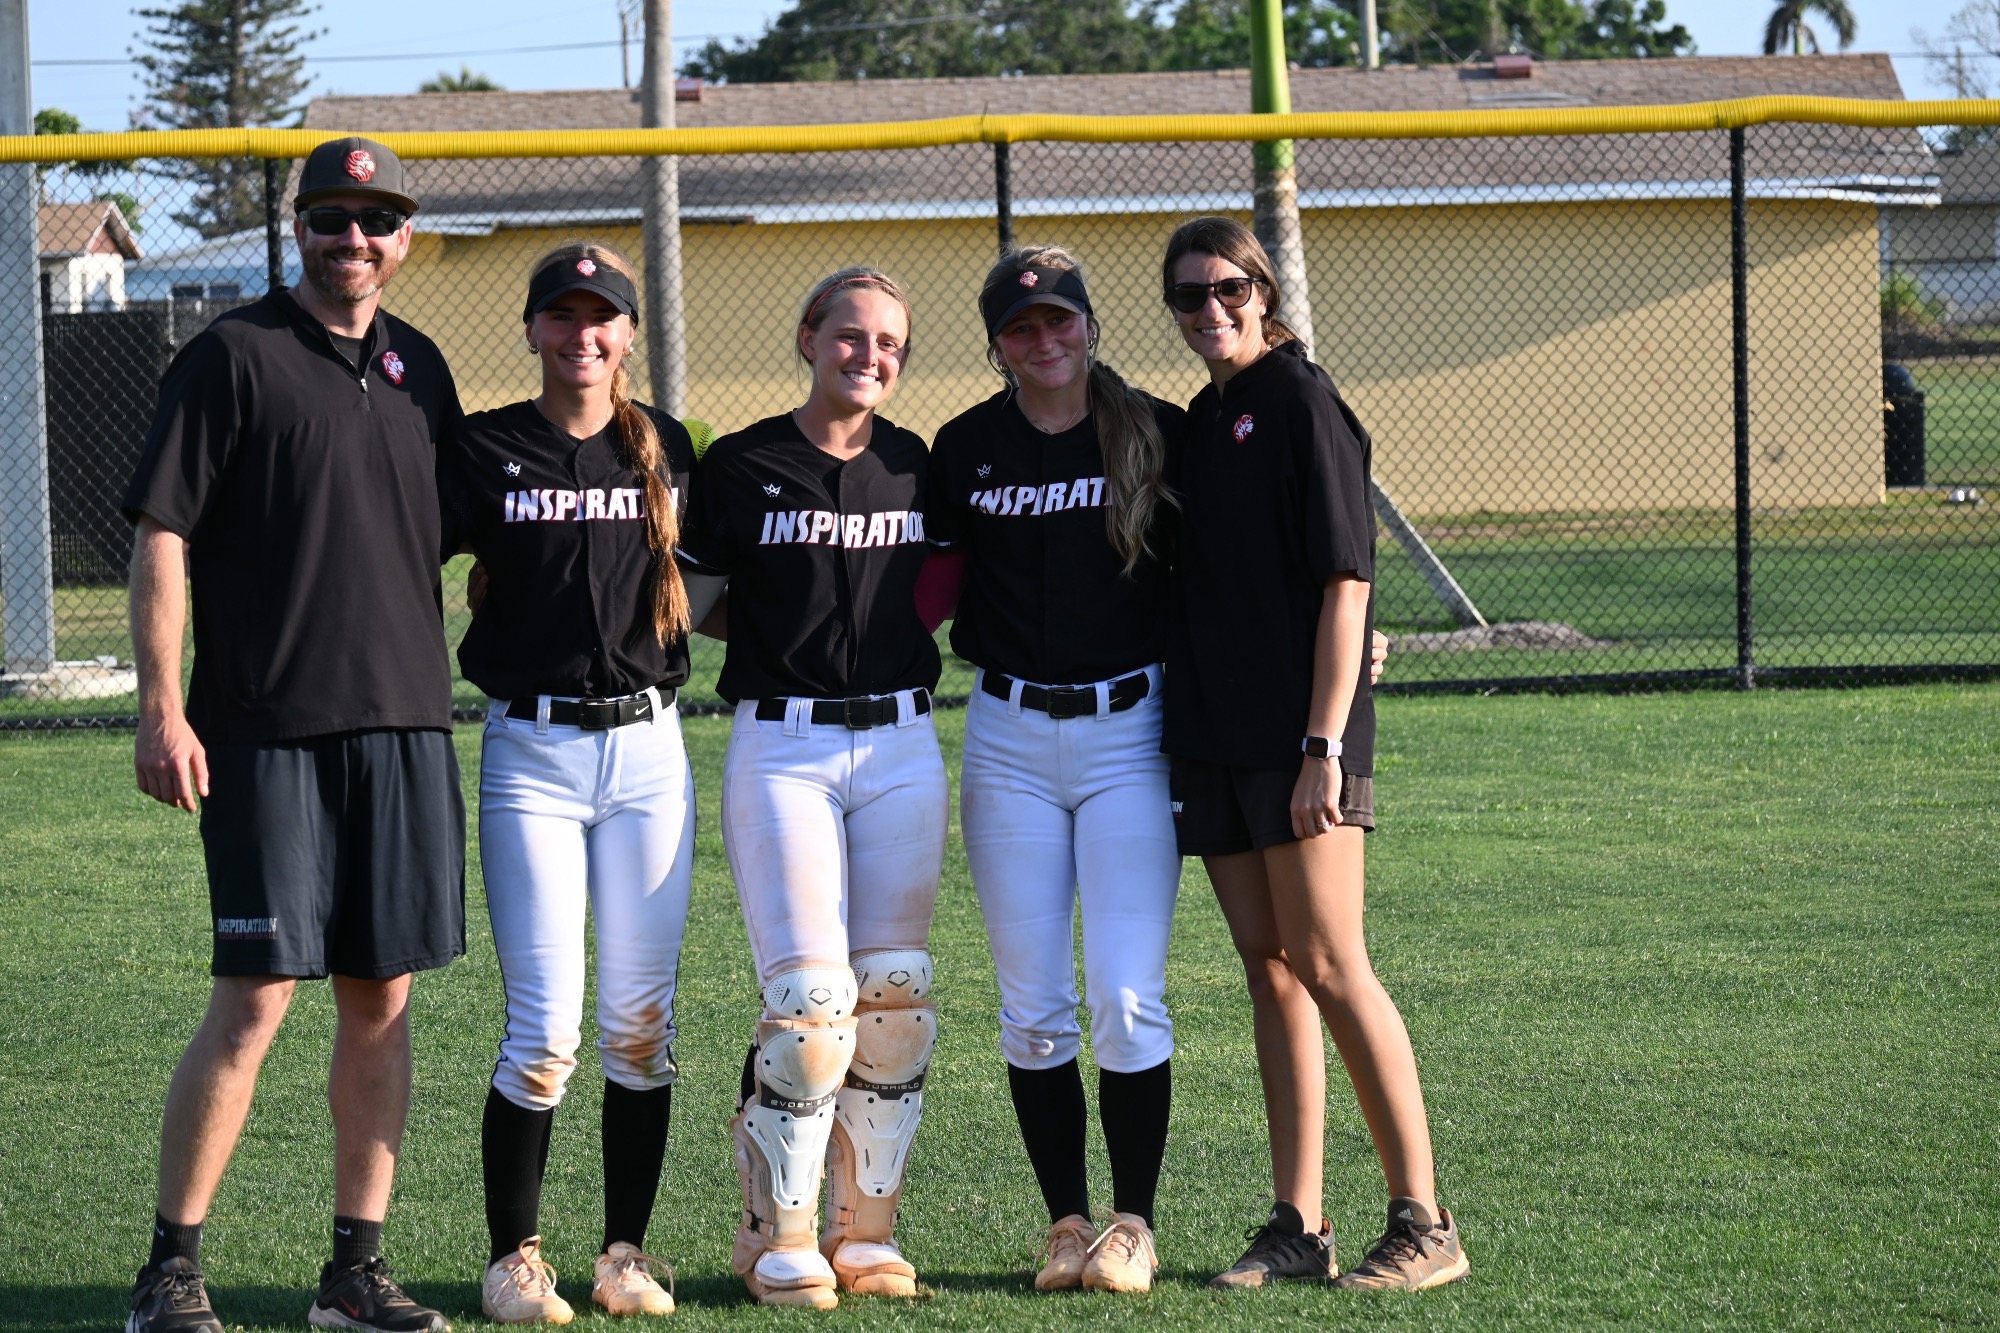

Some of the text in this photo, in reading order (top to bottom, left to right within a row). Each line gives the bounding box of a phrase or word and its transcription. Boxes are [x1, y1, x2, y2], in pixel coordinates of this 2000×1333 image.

[504, 487, 678, 523] INSPIRAT
[969, 476, 1114, 516] INSPIRAT
[218, 917, 278, 933] INSPIRATION
